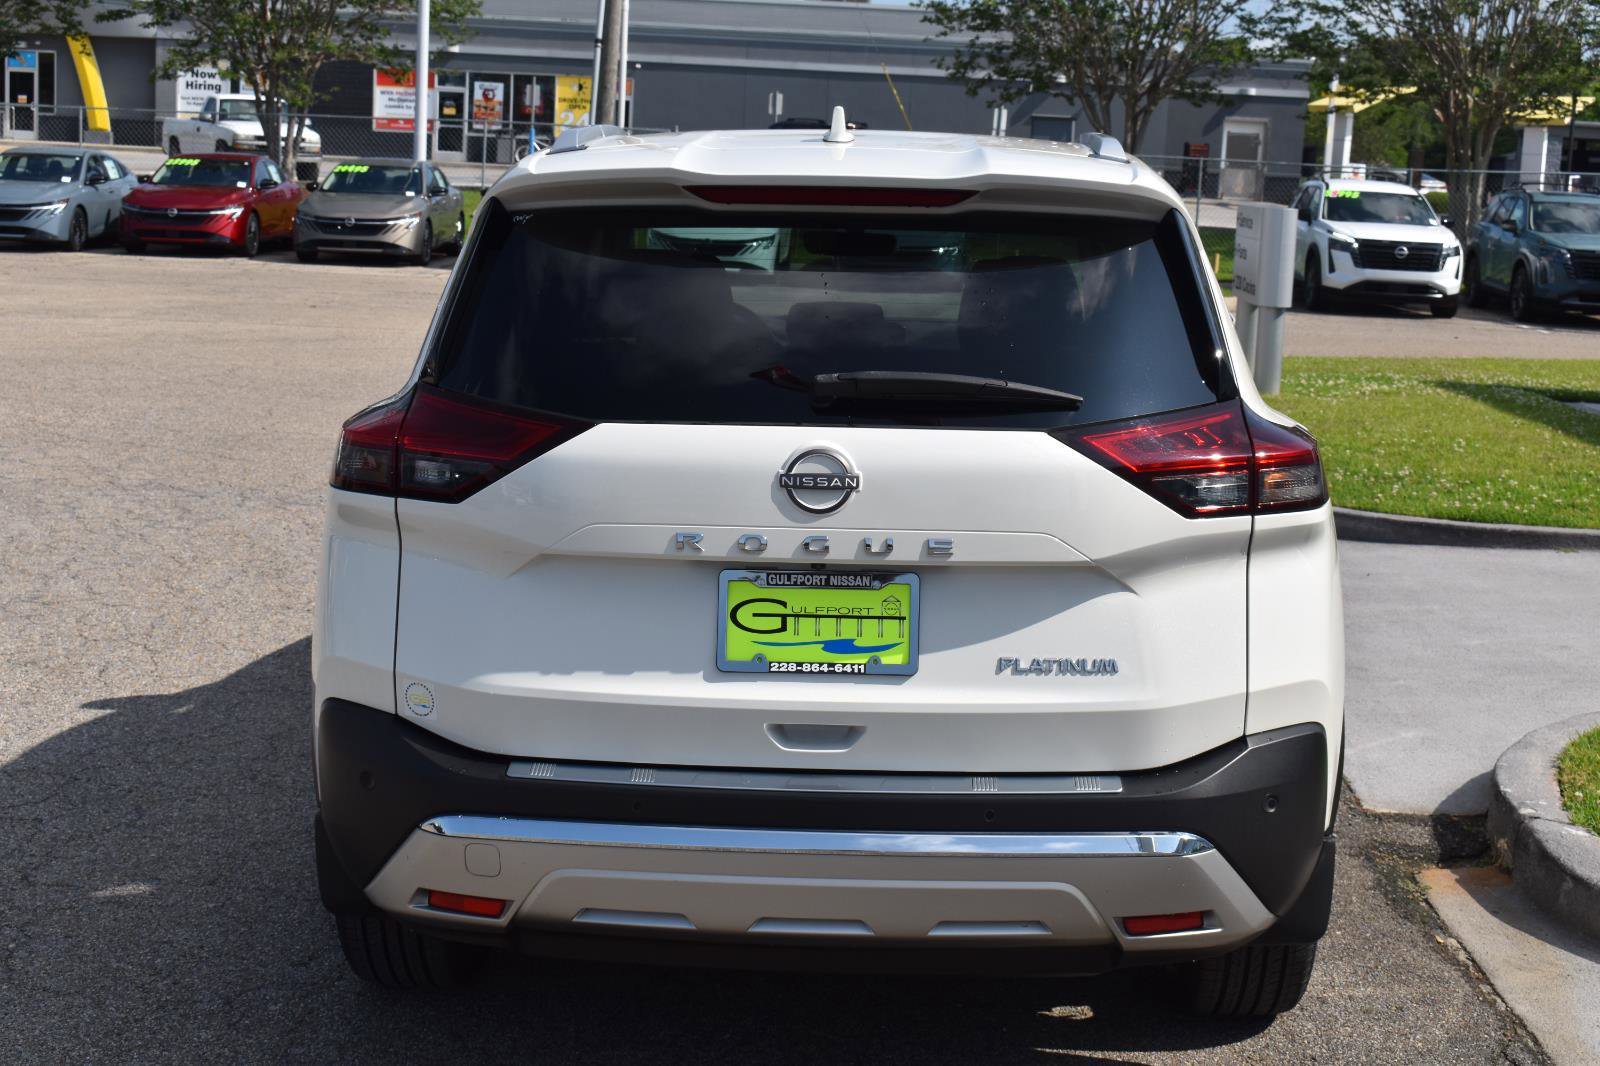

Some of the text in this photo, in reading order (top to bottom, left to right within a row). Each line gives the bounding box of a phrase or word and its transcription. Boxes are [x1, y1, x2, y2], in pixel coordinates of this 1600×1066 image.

[191, 68, 217, 79] Now
[185, 80, 222, 94] Hiring
[781, 476, 857, 488] NISSAN
[675, 532, 954, 556] ROGUE
[768, 574, 871, 587] GULFPORT NISSAN
[769, 662, 866, 674] 228-864-6411
[995, 656, 1119, 677] PLATINUM
